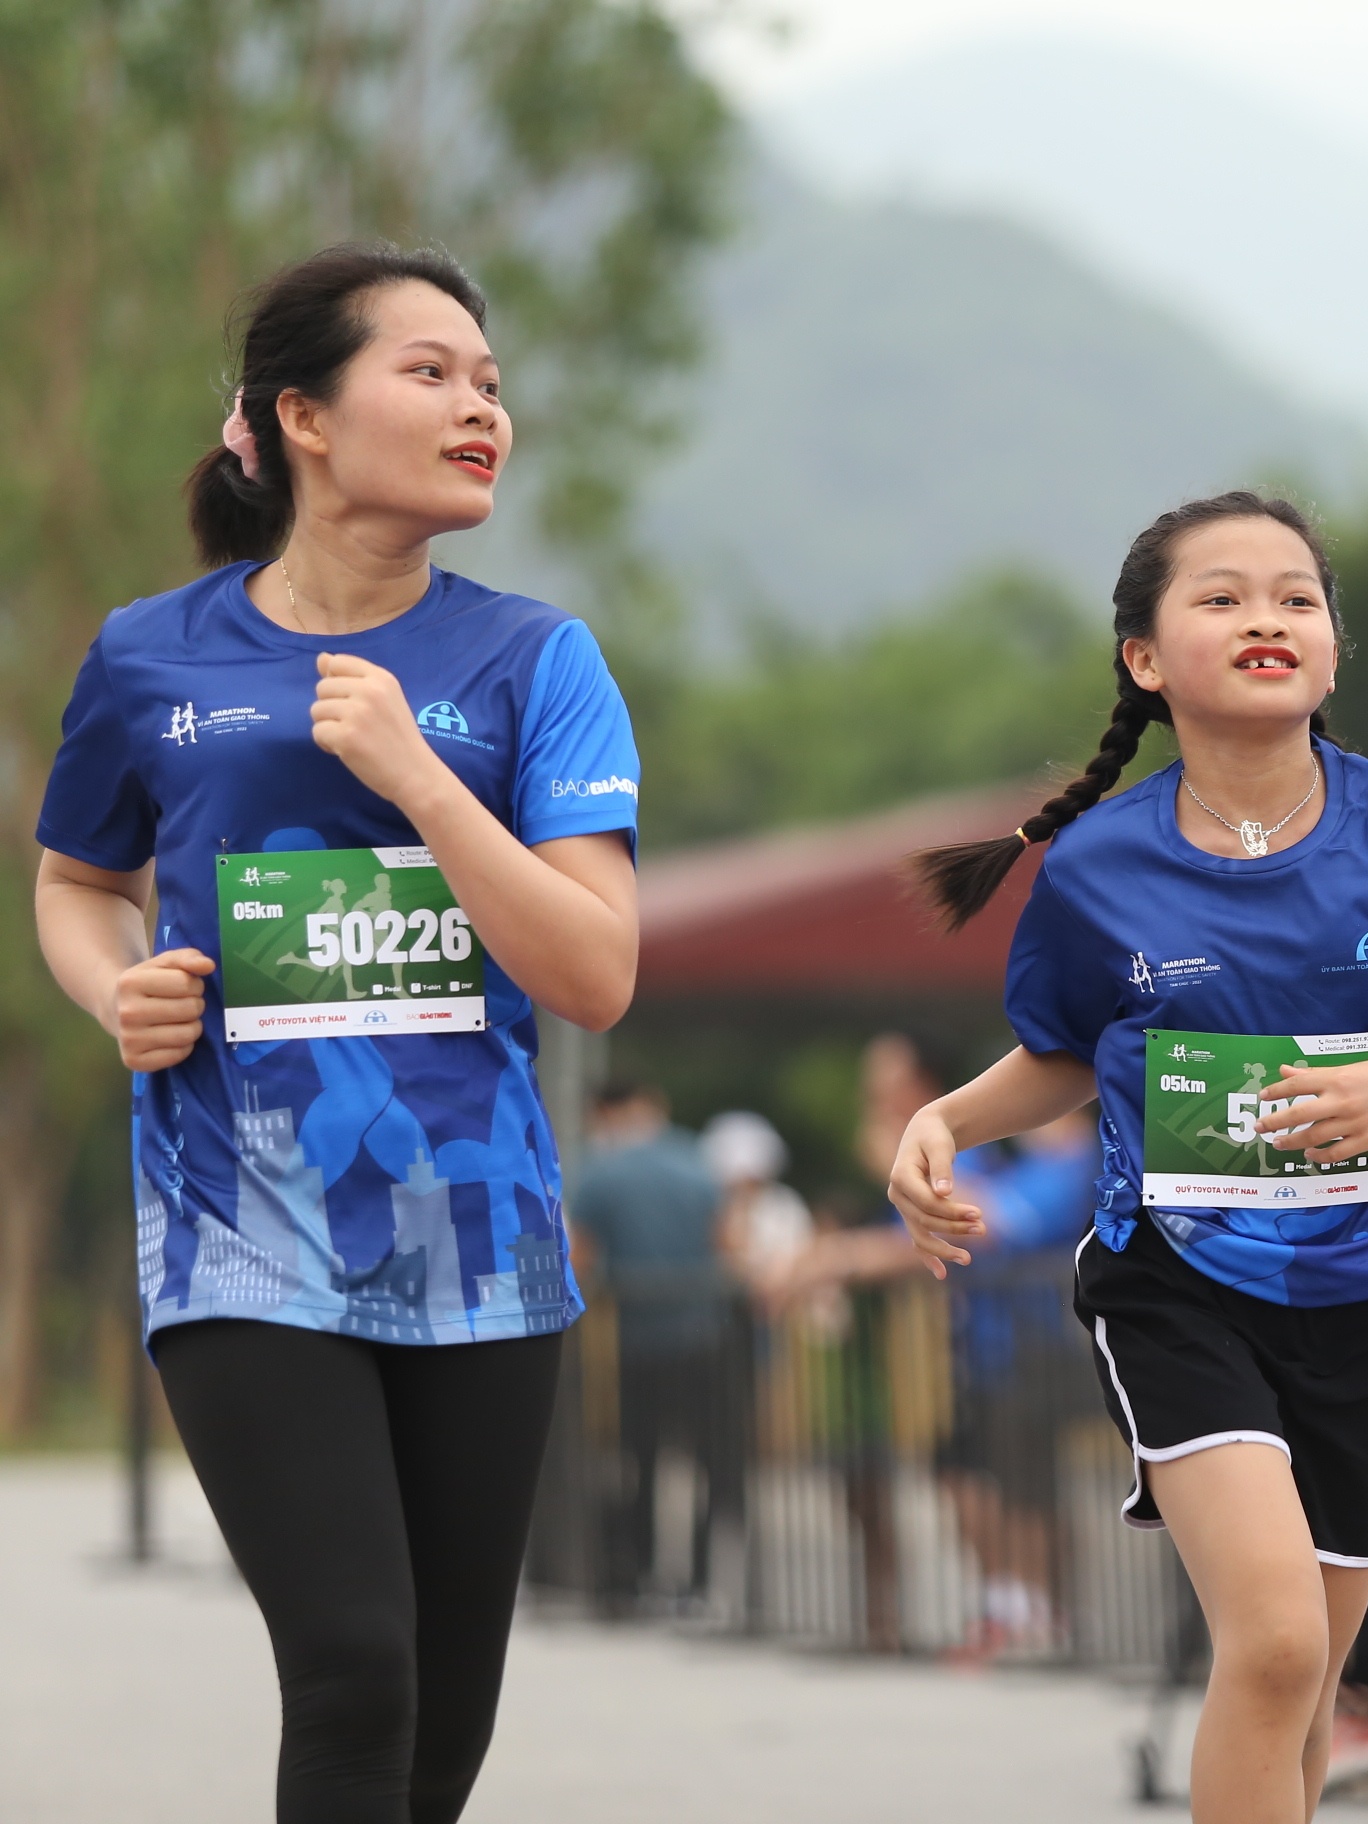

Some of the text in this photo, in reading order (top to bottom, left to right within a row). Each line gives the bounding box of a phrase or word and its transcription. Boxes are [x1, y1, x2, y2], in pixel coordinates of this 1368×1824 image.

[210, 707, 255, 718] MARATHON
[436, 731, 451, 739] GIAO
[233, 901, 284, 920] 05km
[306, 907, 472, 967] 50226
[1162, 957, 1206, 969] MARATHON
[1183, 966, 1198, 974] GIAO
[277, 1017, 307, 1025] TOYOTA
[309, 1015, 326, 1024] VIỆT
[1160, 1074, 1206, 1093] 05km
[1193, 1186, 1221, 1194] TOYOTA
[1223, 1187, 1239, 1196] VIỆT
